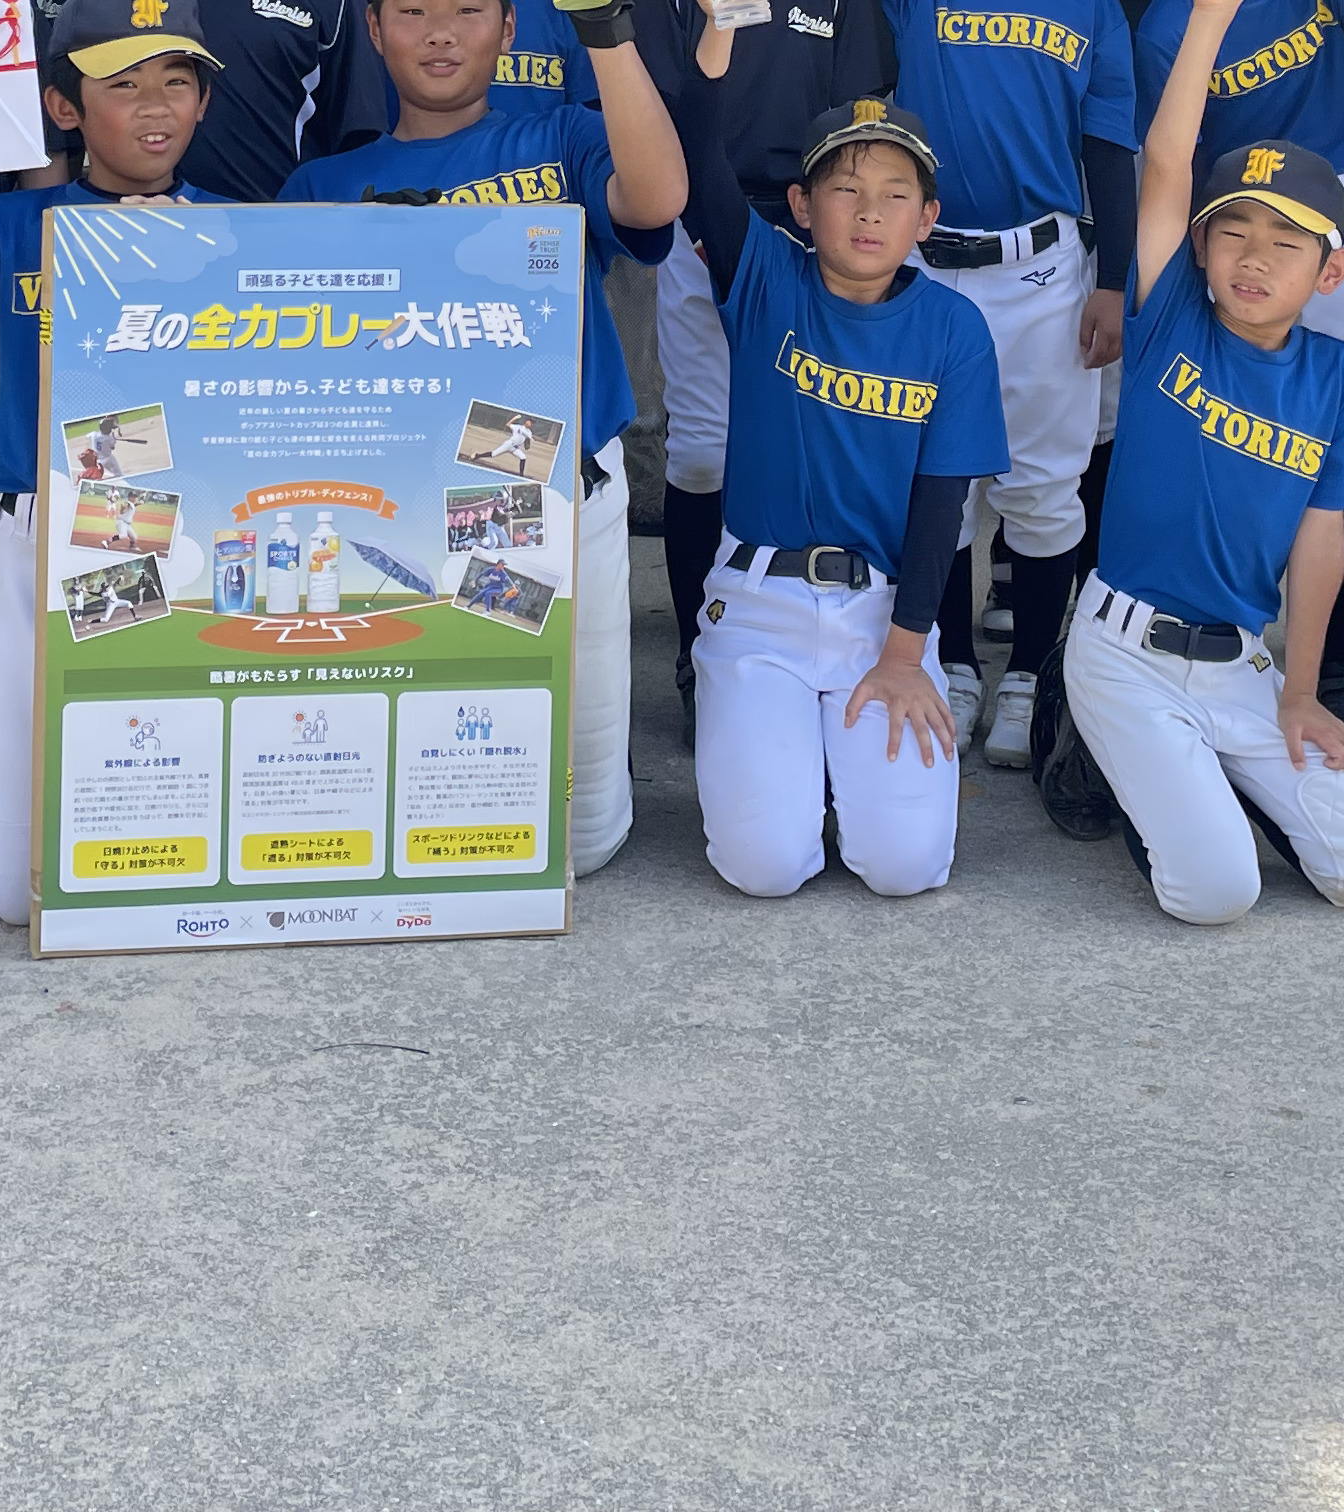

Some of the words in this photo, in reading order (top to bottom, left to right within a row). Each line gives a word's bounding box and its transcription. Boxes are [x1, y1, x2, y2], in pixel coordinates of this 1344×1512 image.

[937, 11, 1079, 63] ICTORIES
[437, 167, 561, 204] ORIES
[528, 258, 560, 270] 2026
[245, 273, 393, 289] 頑張る子ども達を応援!
[106, 301, 532, 353] 夏の全力プレー大作戦
[184, 376, 452, 398] 暑さの影響から、子ども達を守る!
[209, 665, 414, 685] 酷暑がもたらす「見えないリスク」
[257, 751, 361, 764] 防ぎようのない直射日光
[412, 830, 531, 844] スポーツドリンクなどによる
[102, 844, 179, 857] 日焼け止めによる
[261, 850, 352, 863] 「遮る」対策が不可欠
[93, 857, 186, 871] 「守る」対策が不可欠
[287, 907, 359, 925] MOONBAT
[177, 918, 230, 934] ROHTO
